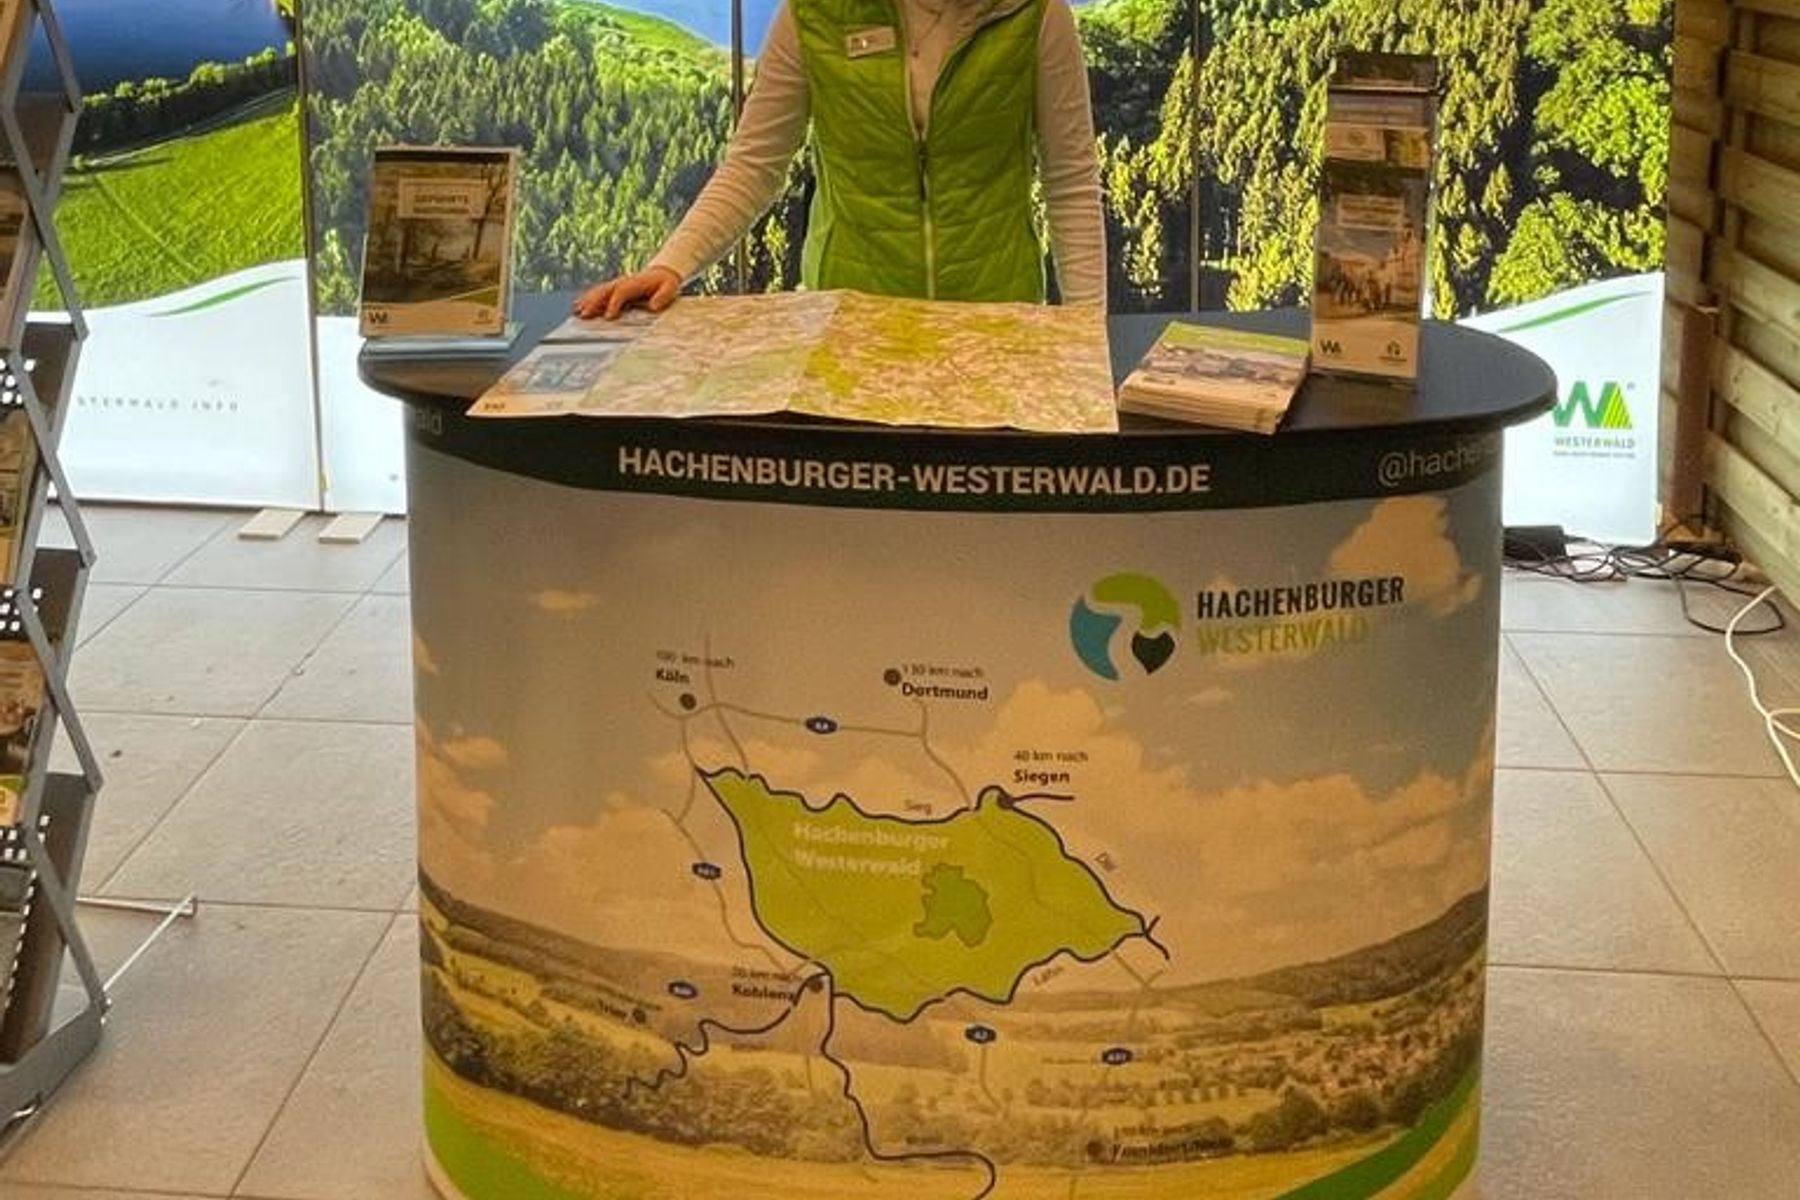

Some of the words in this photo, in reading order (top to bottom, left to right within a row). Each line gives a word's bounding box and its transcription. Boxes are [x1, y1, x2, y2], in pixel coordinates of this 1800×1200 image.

[1554, 435, 1637, 450] WESTERWALD
[618, 444, 1211, 497] HACHENBURGER-WESTERWALD.DE
[1196, 575, 1405, 620] HACHENBURGER
[1197, 614, 1369, 656] WESTERWALD
[655, 668, 691, 684] Köln
[901, 681, 989, 701] Dortmund
[1013, 768, 1070, 786] Siegen
[793, 822, 951, 852] Hachenburger
[794, 848, 922, 876] Westerwald
